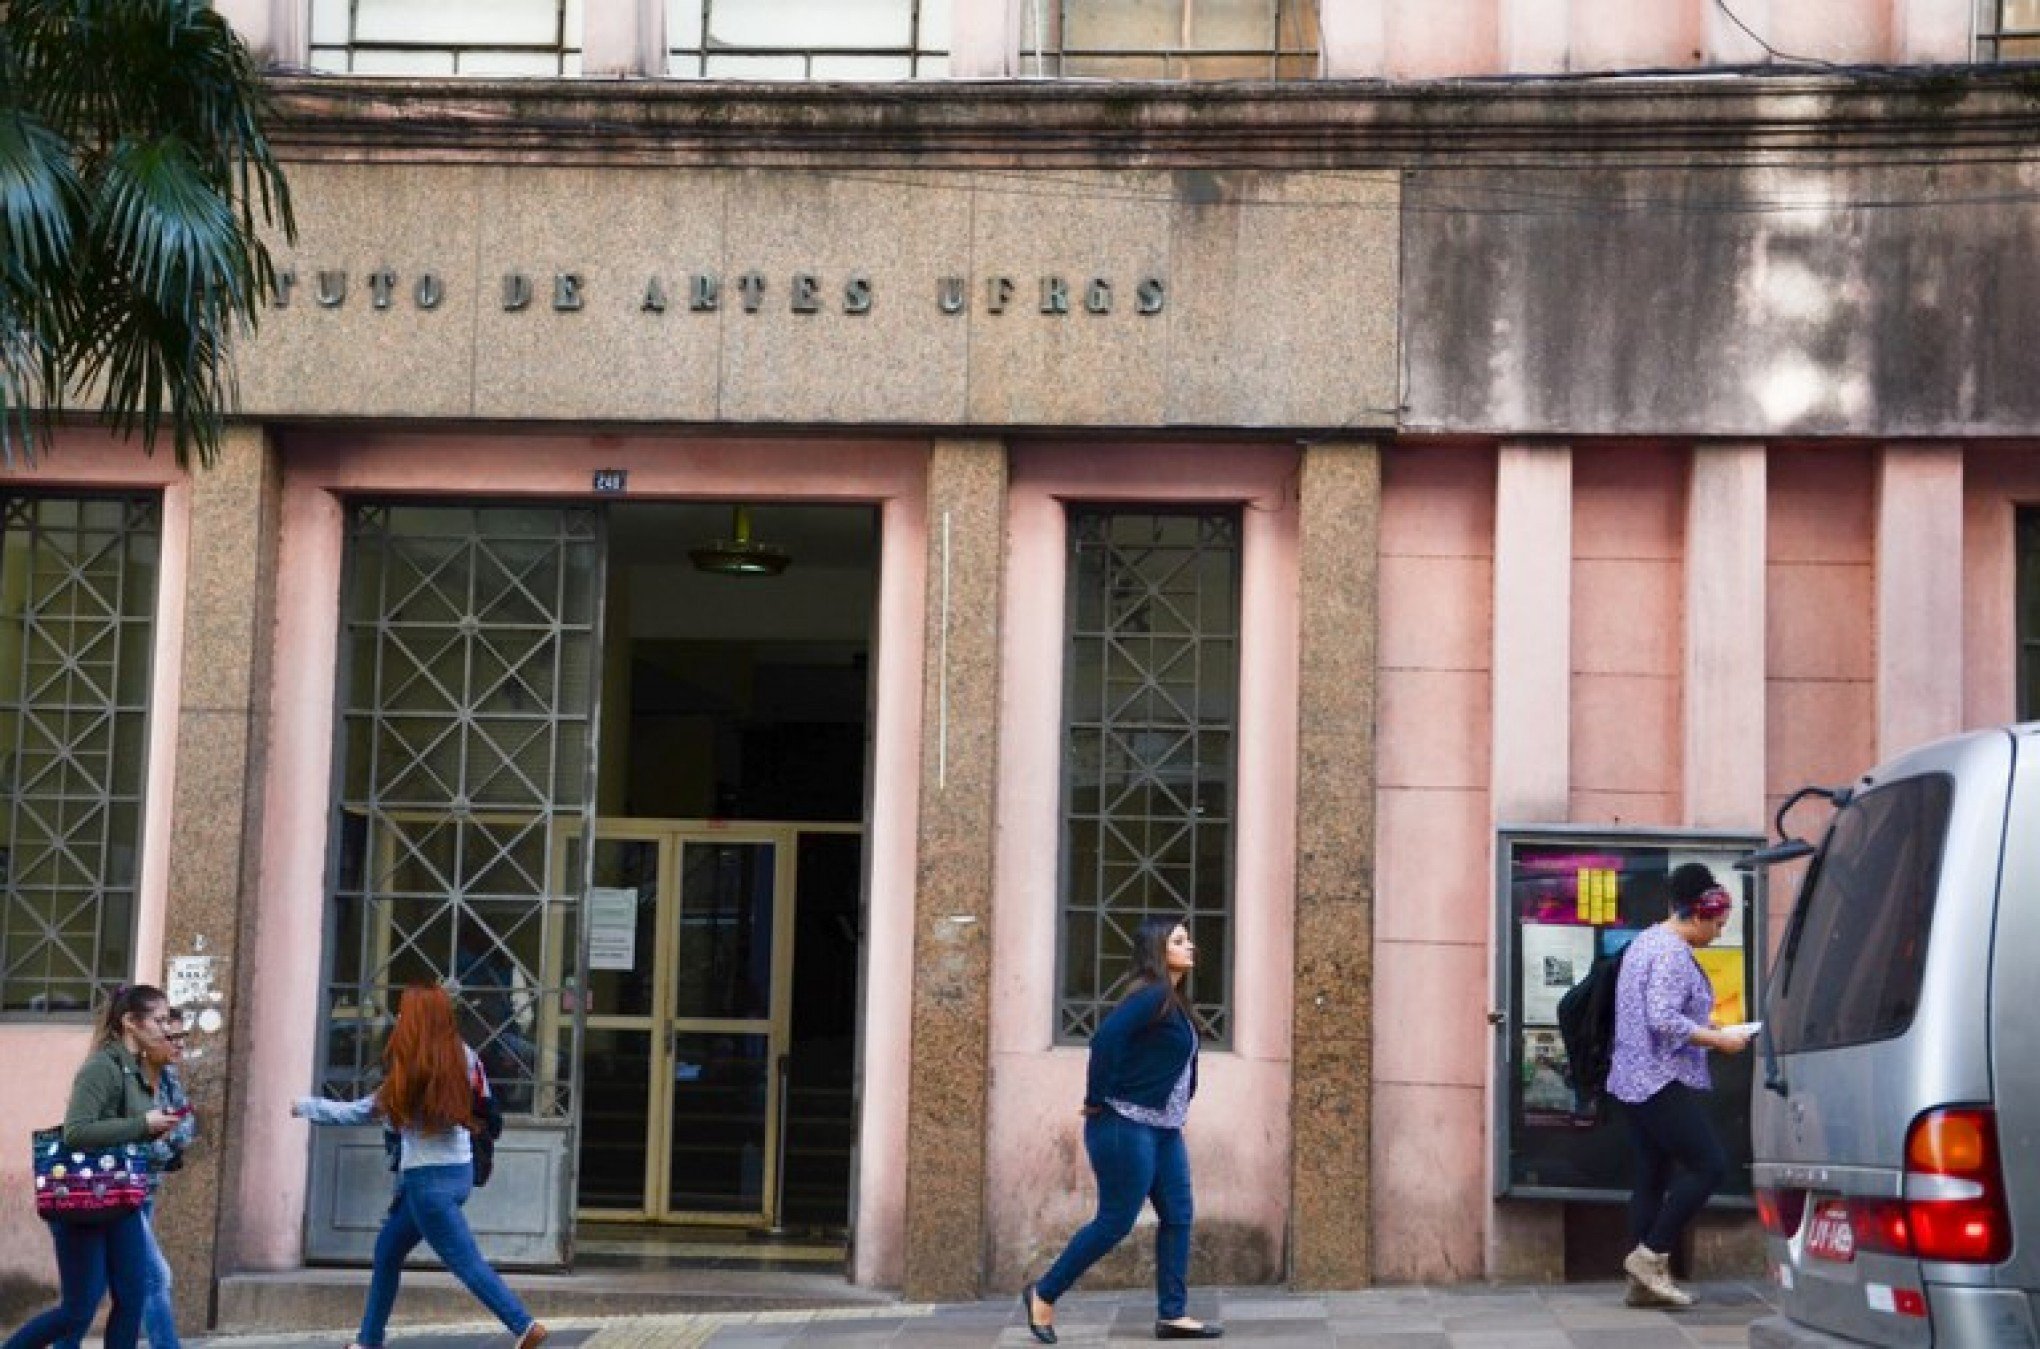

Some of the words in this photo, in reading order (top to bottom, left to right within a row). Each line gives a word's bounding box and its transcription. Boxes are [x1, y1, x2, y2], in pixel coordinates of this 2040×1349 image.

[503, 273, 584, 313] DE
[641, 273, 871, 315] ARTES
[937, 277, 1165, 316] UFRGS
